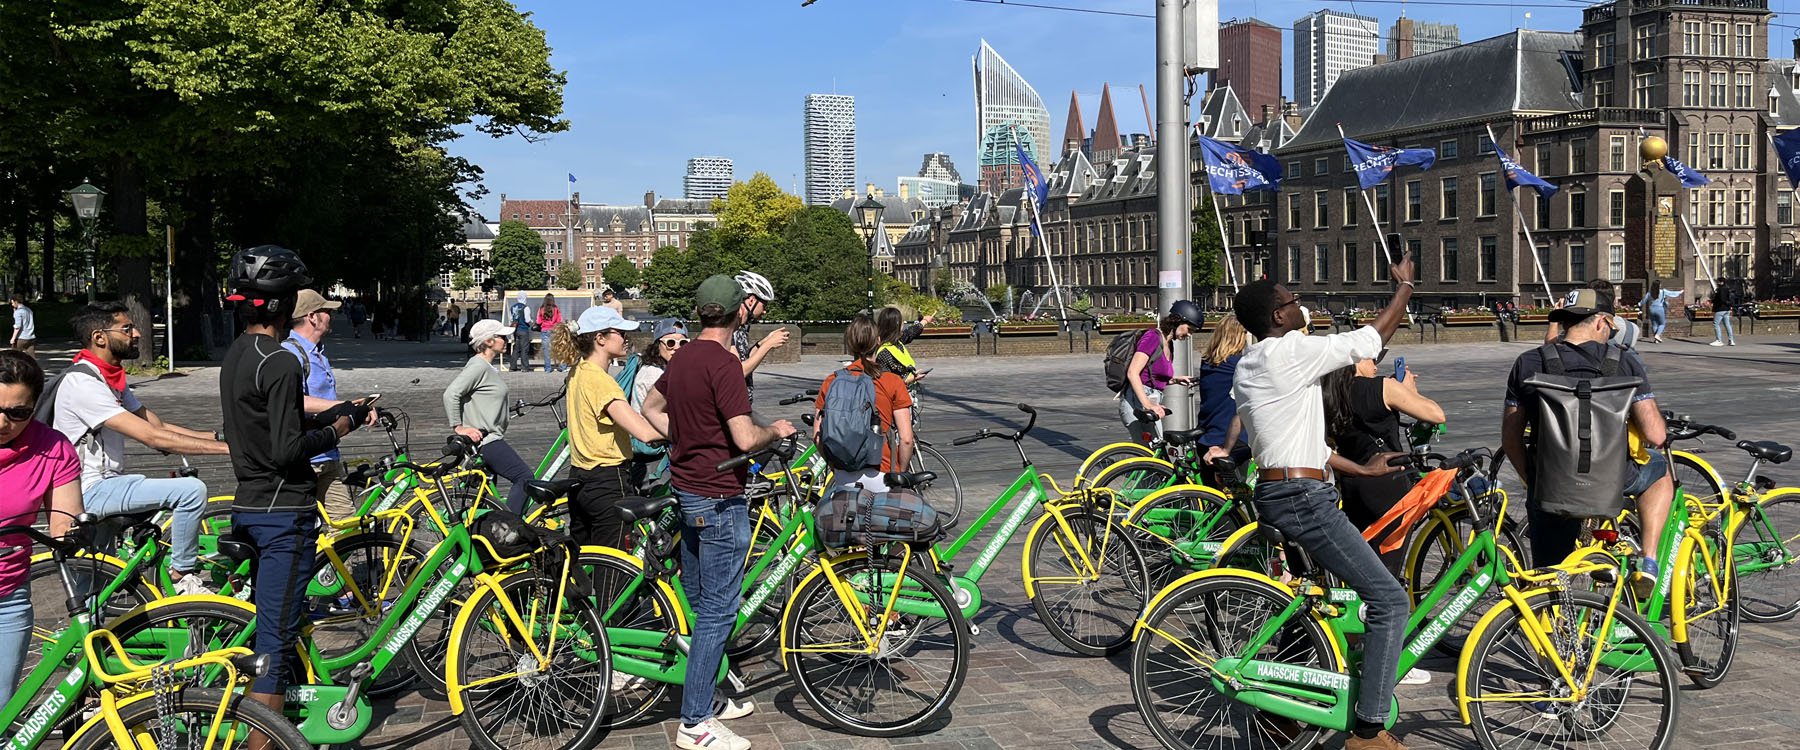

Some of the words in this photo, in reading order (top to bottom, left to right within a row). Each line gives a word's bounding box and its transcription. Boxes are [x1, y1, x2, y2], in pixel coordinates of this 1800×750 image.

[977, 533, 1006, 568] HAAGSCHE
[1001, 498, 1032, 536] STADSFIETS
[384, 615, 422, 655] HAAGSCHE
[415, 578, 454, 619] STADSFIETS
[740, 584, 771, 618] HAAGSCHE
[766, 553, 797, 588] STADSFIETS
[1407, 619, 1446, 657] HAAGSCHE
[1439, 586, 1479, 625] STADSFIETS
[1257, 664, 1300, 682] HAAGSCHE
[1302, 672, 1349, 690] STADSFIETS
[16, 690, 66, 747] STADSFIETS
